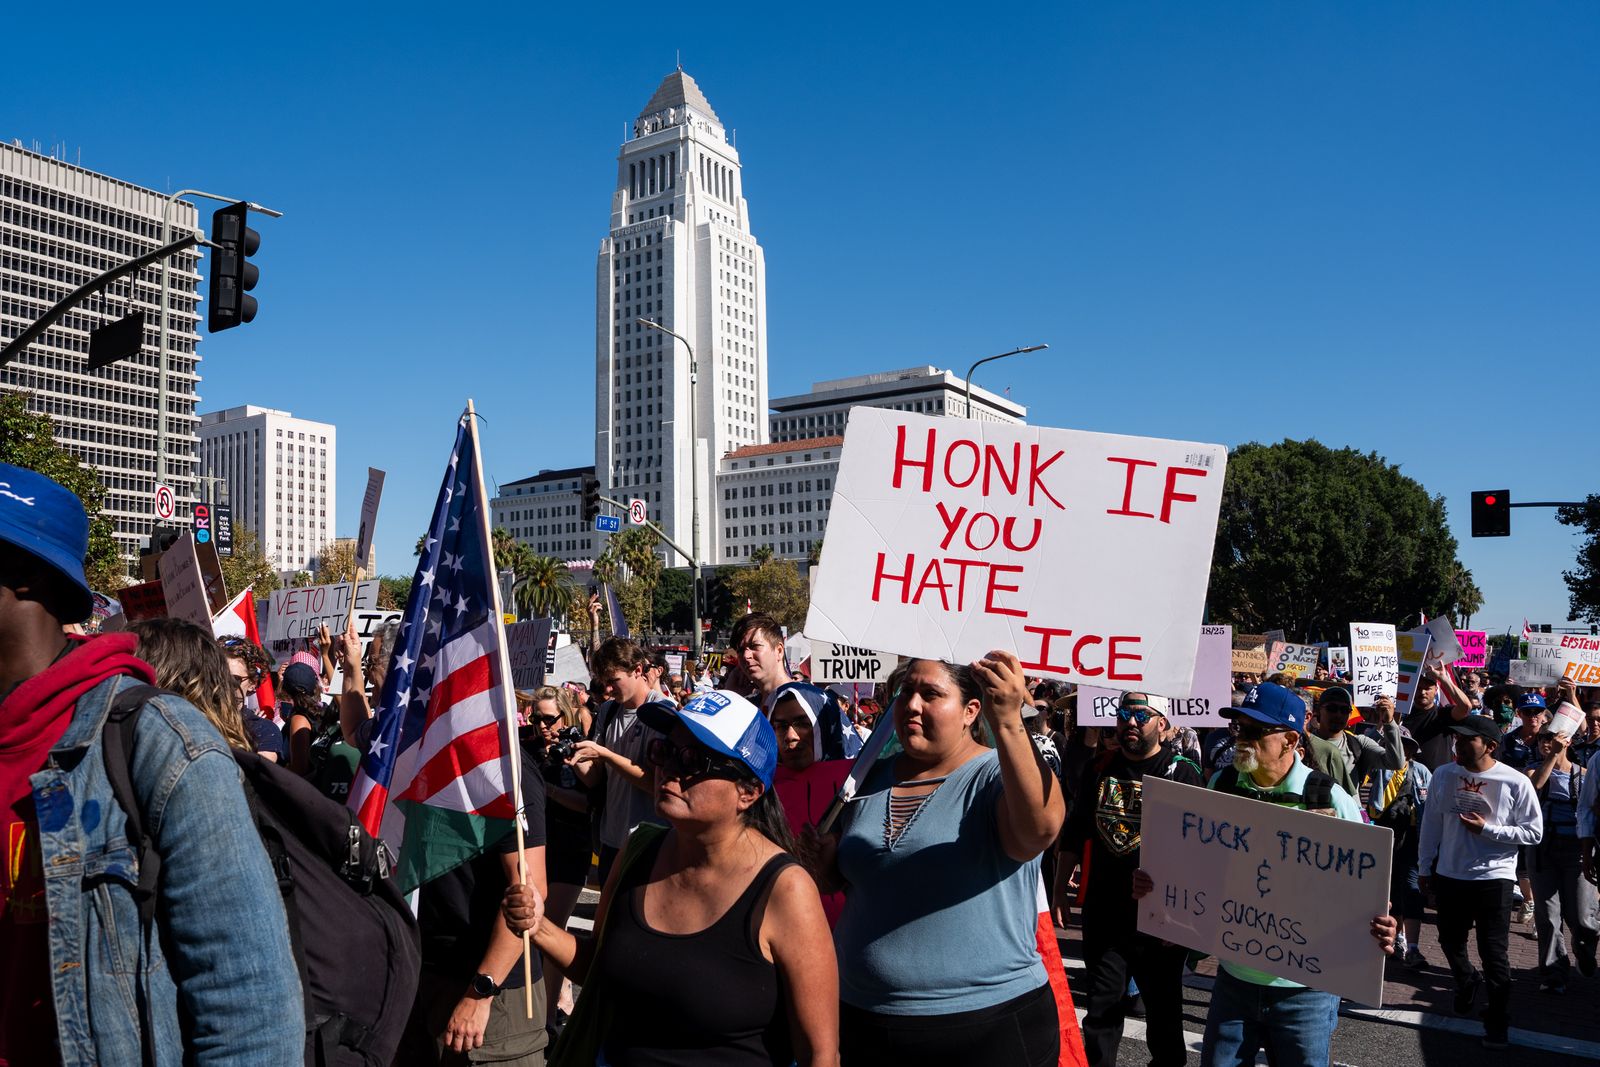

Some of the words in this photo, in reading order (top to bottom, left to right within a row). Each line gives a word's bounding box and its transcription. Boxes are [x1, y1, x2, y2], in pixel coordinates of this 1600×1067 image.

[892, 425, 1065, 510] HONK
[1107, 457, 1207, 524] IF
[598, 518, 608, 528] 1st
[610, 520, 617, 529] St
[936, 502, 1042, 552] YOU
[333, 584, 370, 610] THE
[872, 553, 1028, 618] HATE
[1020, 625, 1143, 681] ICE
[1533, 647, 1562, 659] TIME
[1560, 635, 1600, 652] EPSTEIN
[819, 658, 882, 680] TRUMP
[1357, 655, 1370, 668] NO
[1530, 662, 1556, 678] THE
[330, 782, 349, 795] 73
[1182, 812, 1251, 852] FUCK
[1276, 830, 1376, 880] TRUMP
[1165, 883, 1206, 916] HIS
[1221, 900, 1308, 945] SUCKASS
[1222, 930, 1322, 974] GOONS
